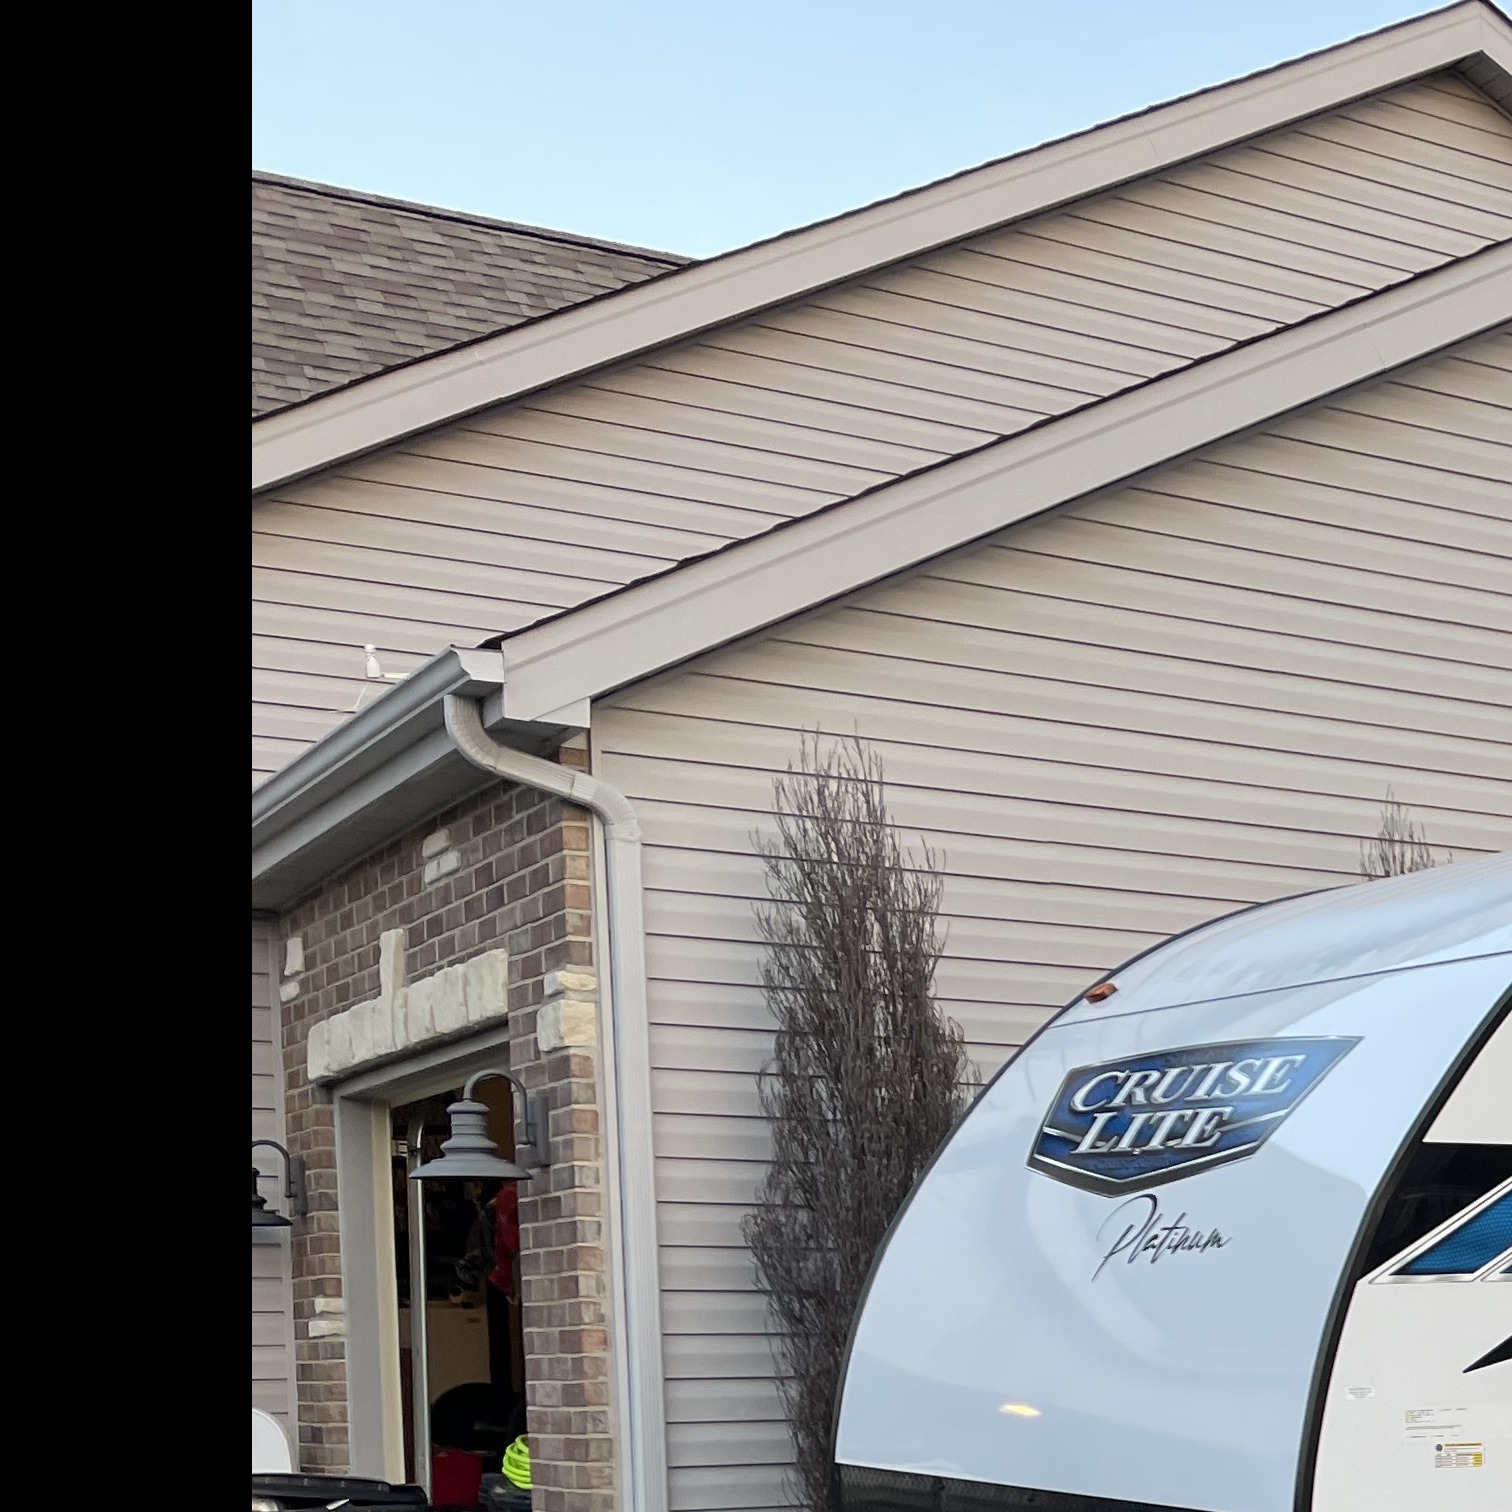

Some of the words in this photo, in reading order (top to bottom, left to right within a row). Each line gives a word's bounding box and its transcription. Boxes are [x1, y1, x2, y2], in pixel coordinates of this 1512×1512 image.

[1070, 1054, 1307, 1112] CRUISE
[1070, 1106, 1235, 1155] LITE
[1091, 1193, 1234, 1282] Platinum
